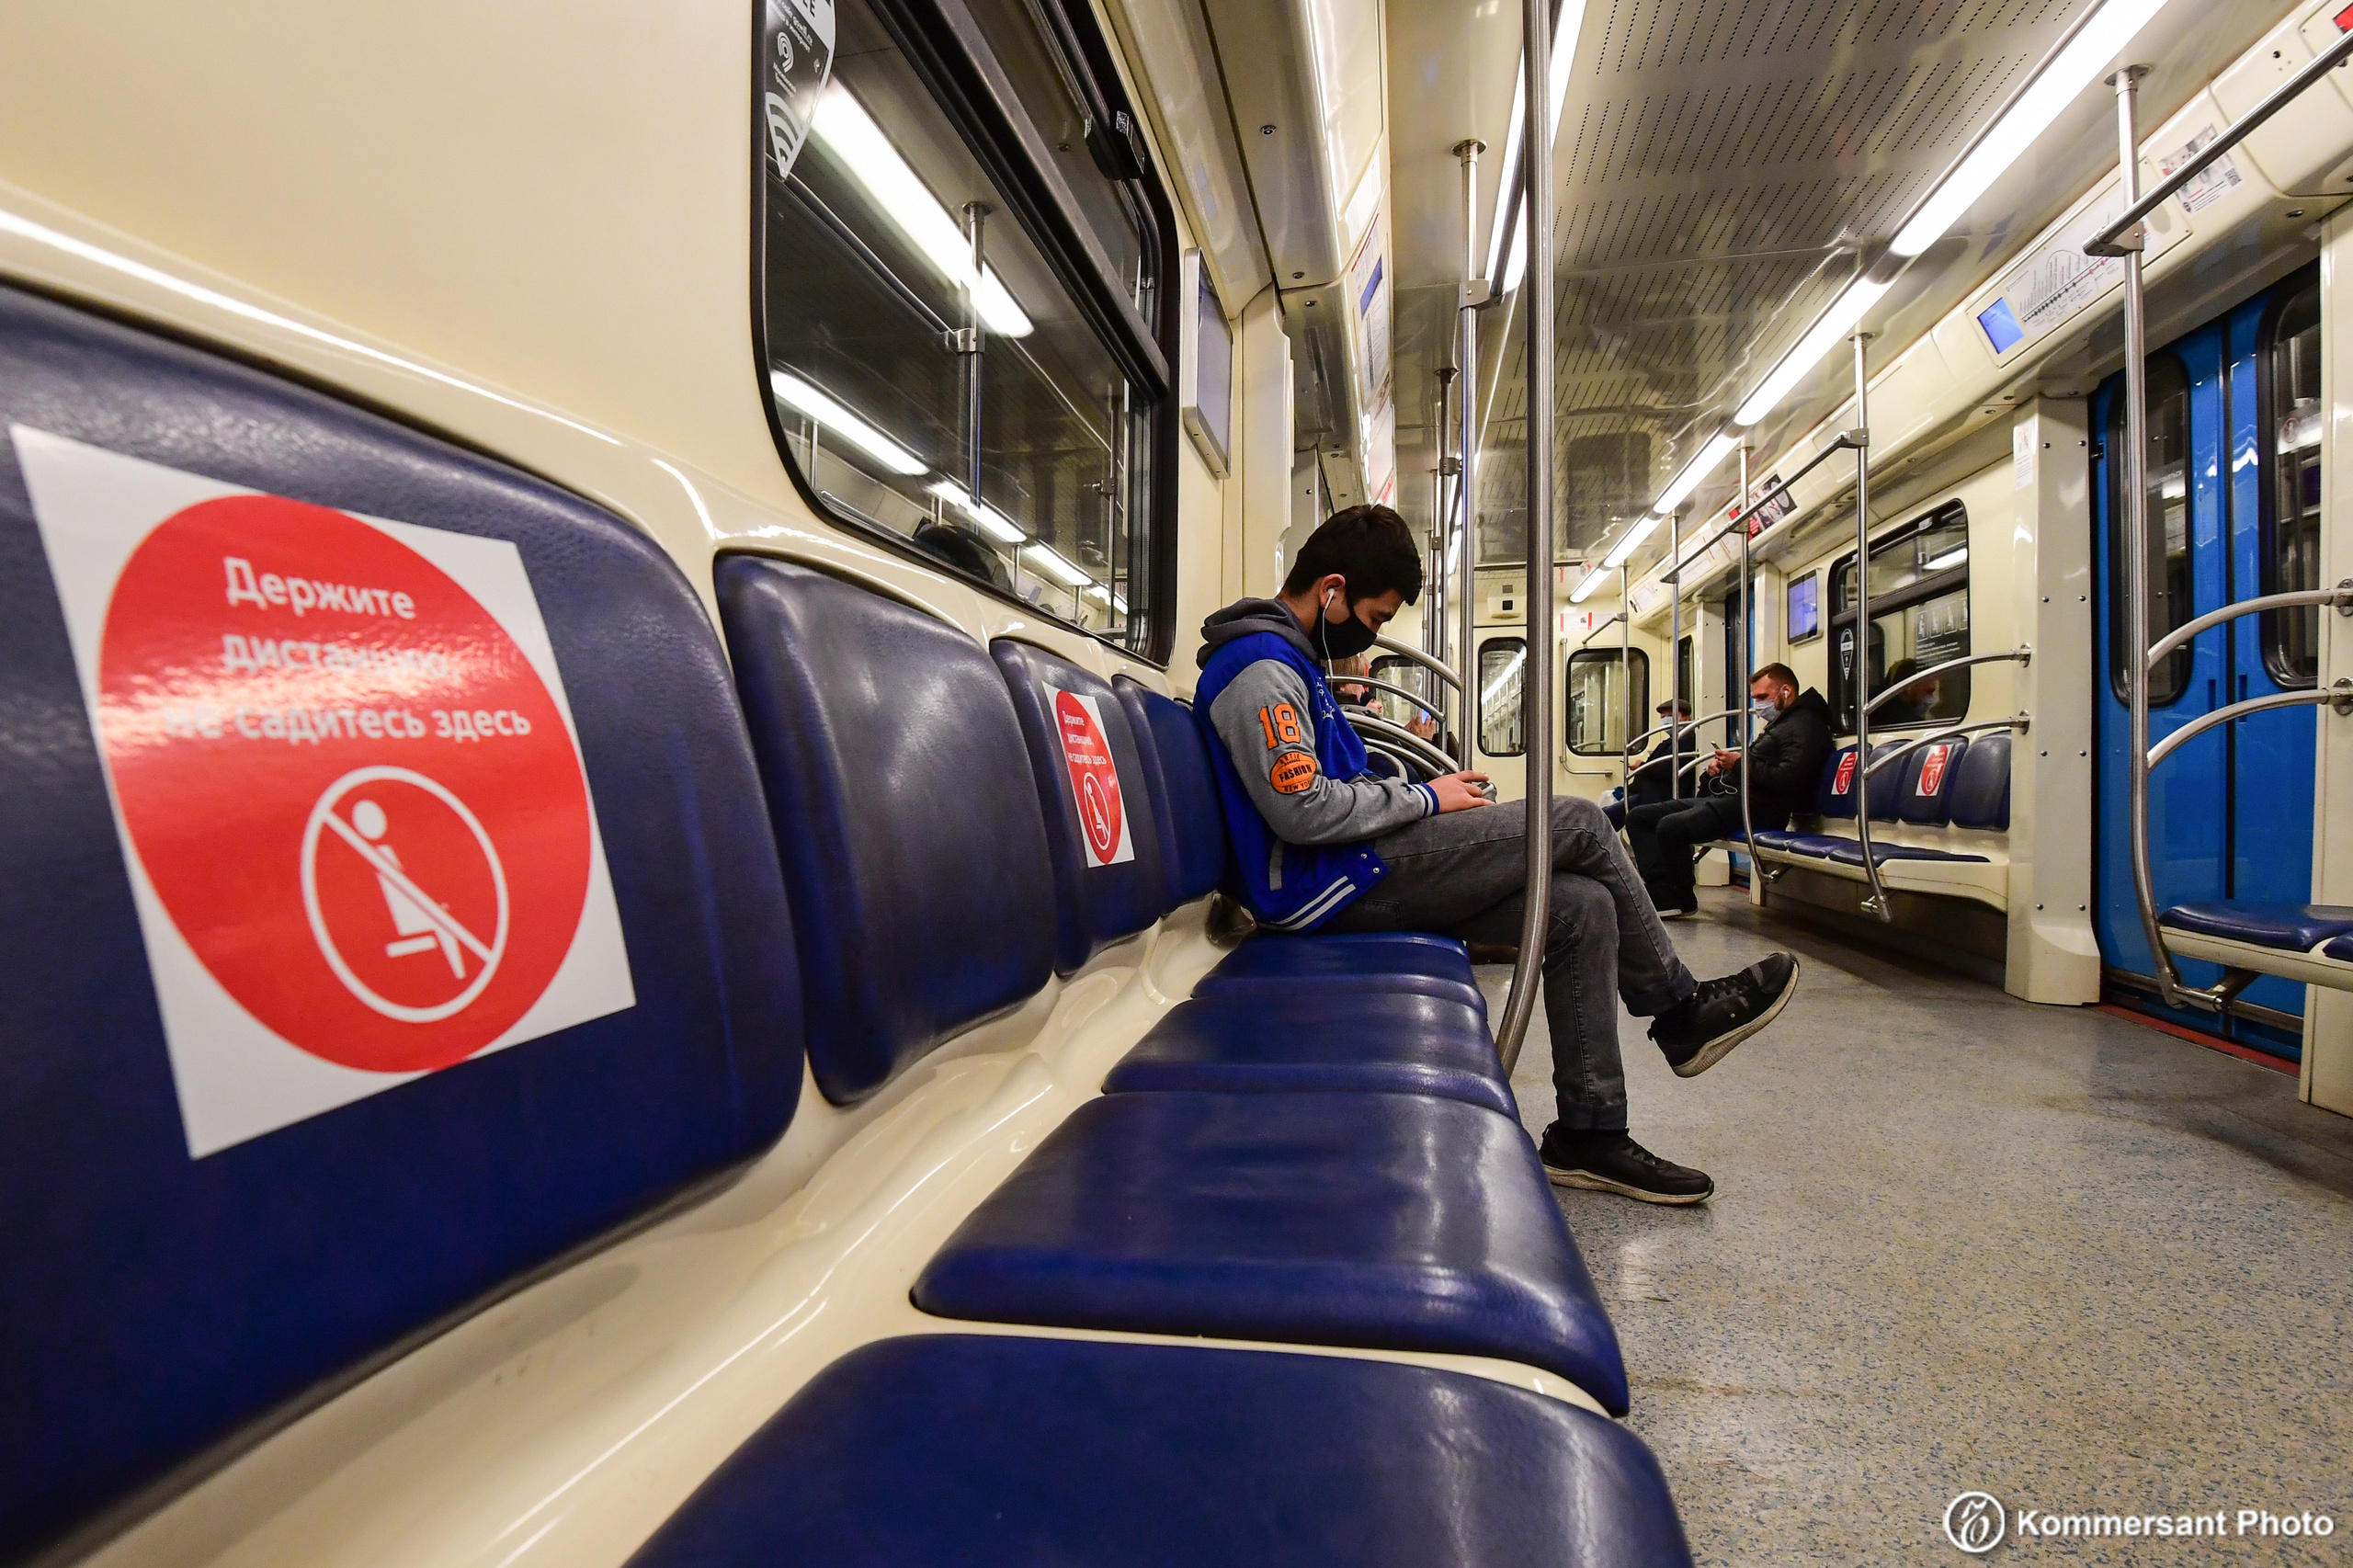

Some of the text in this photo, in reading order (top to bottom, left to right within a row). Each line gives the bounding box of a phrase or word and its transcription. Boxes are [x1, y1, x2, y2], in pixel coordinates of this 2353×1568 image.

[223, 556, 416, 619] Держите
[162, 703, 533, 745] не садитесь здесь
[1258, 703, 1302, 751] 18
[1279, 764, 1313, 783] FASHION
